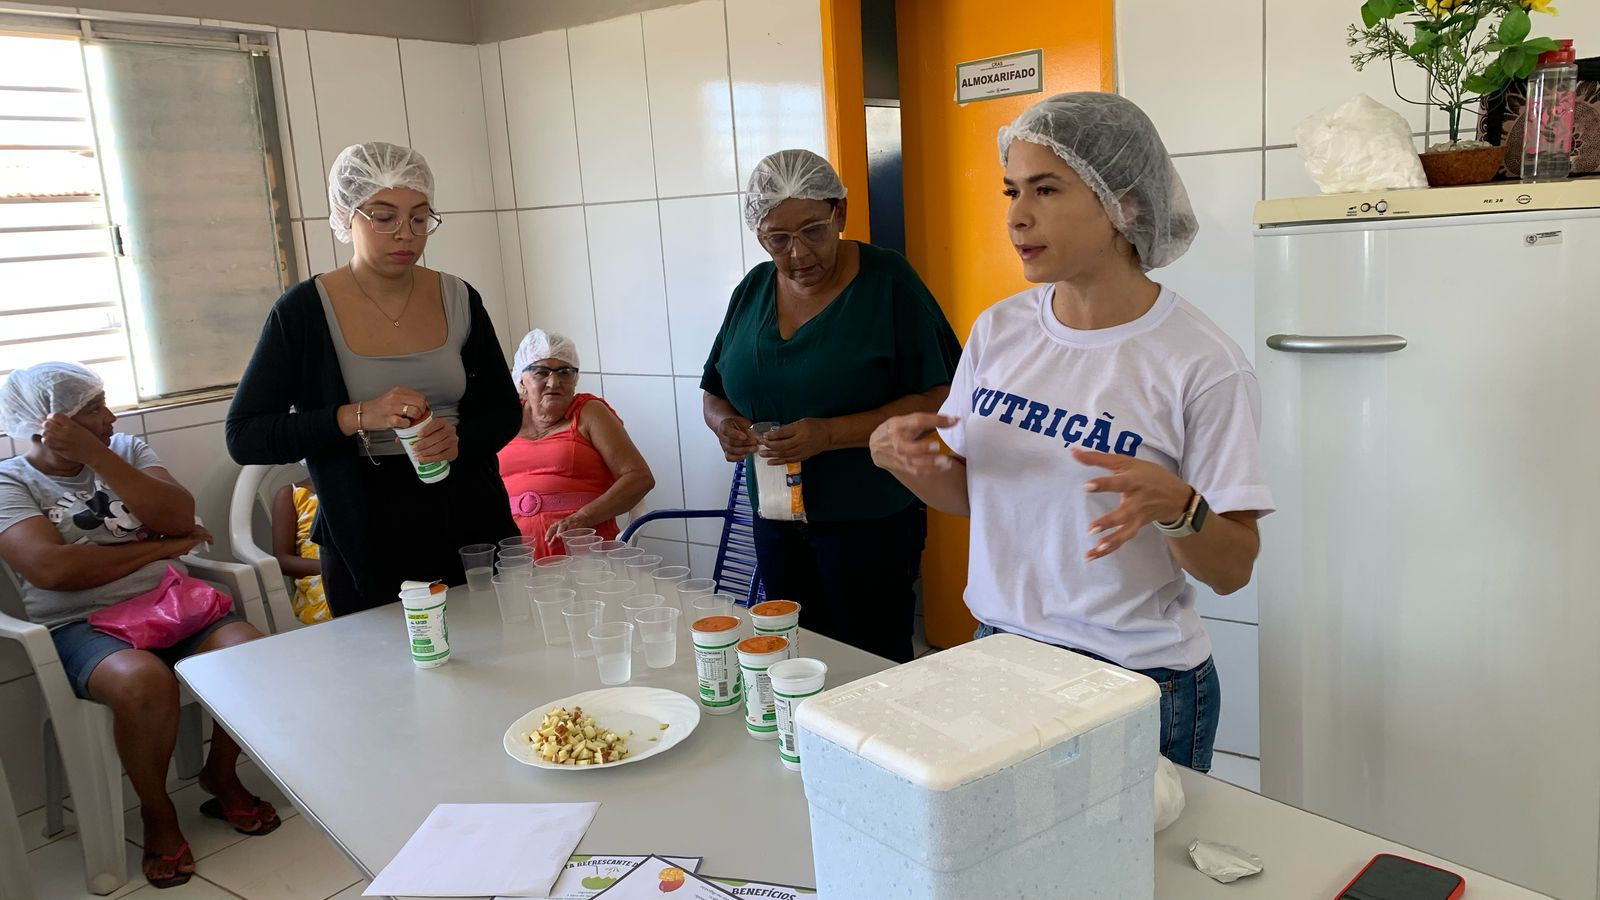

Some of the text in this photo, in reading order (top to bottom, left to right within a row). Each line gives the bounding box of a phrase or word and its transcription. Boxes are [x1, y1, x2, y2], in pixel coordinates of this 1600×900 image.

[961, 67, 1035, 88] ALMOXARIFADO
[576, 859, 632, 867] REFRESCANTE
[732, 887, 797, 900] BENEFÍCIOS
